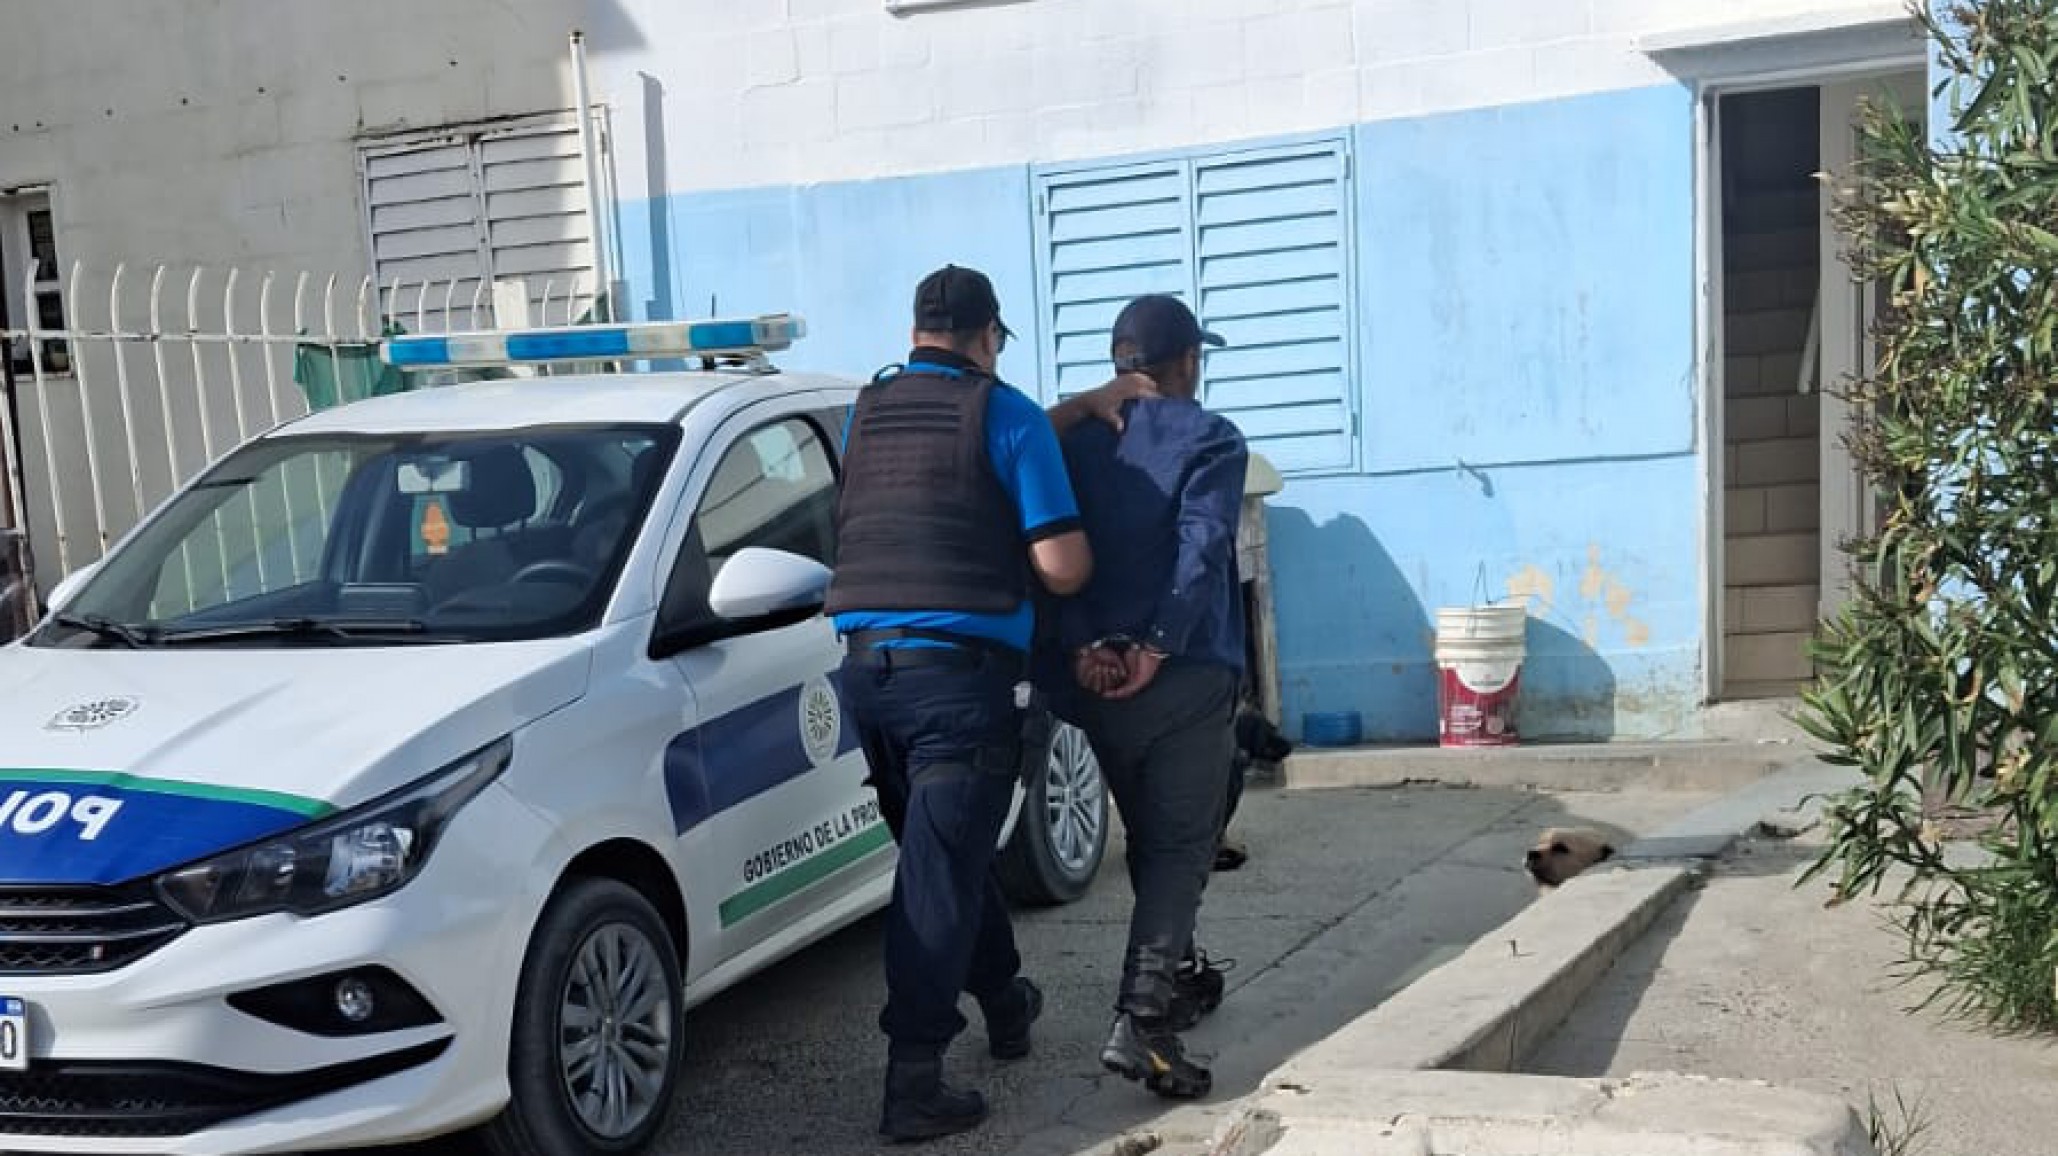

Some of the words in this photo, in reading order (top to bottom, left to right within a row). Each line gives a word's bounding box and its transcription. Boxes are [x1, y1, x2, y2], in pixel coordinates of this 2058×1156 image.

[744, 831, 813, 883] GOBIERNO
[814, 820, 834, 848] DE
[833, 812, 852, 838] LA
[851, 799, 879, 829] PRO
